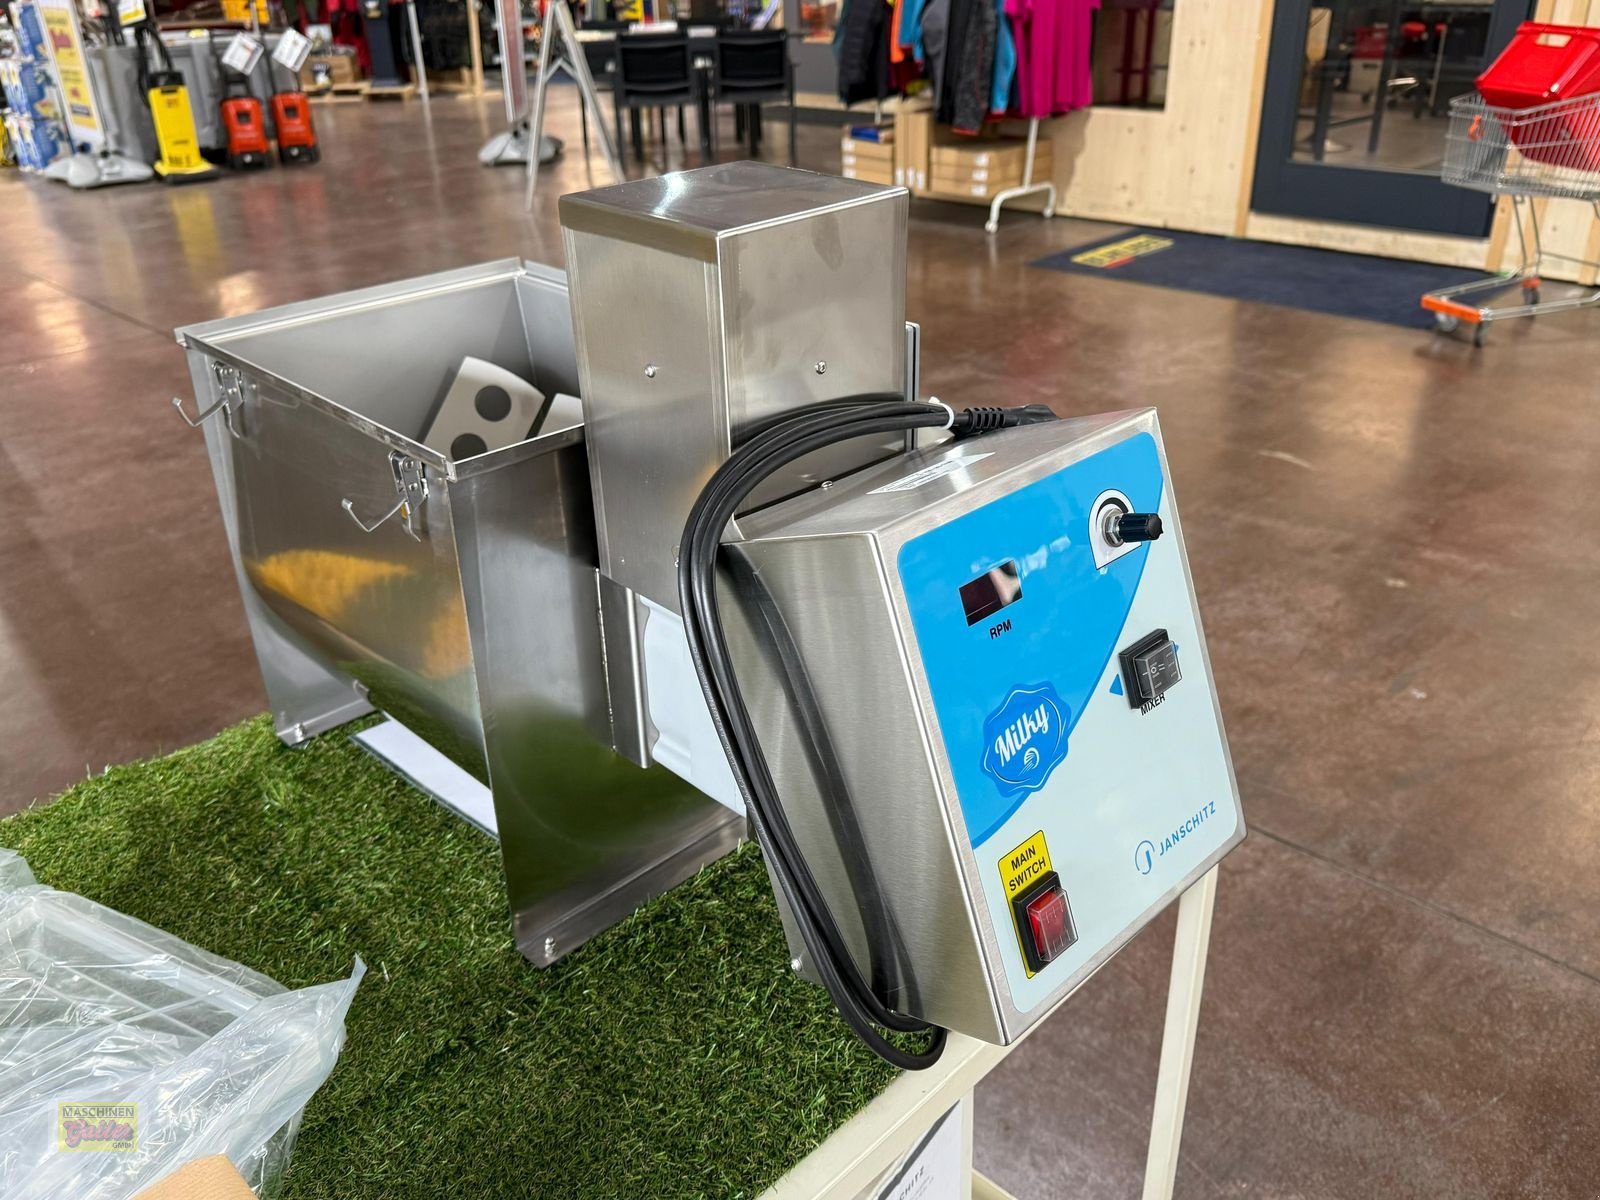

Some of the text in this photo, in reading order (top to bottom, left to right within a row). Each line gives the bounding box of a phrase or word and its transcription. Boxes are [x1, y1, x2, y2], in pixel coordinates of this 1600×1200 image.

[989, 619, 1013, 640] RPM
[1140, 692, 1166, 716] MIXER
[994, 703, 1050, 767] Milky
[1158, 800, 1217, 856] JANSCHITZ
[1011, 845, 1036, 871] MAIN
[1009, 856, 1047, 892] SWITCH
